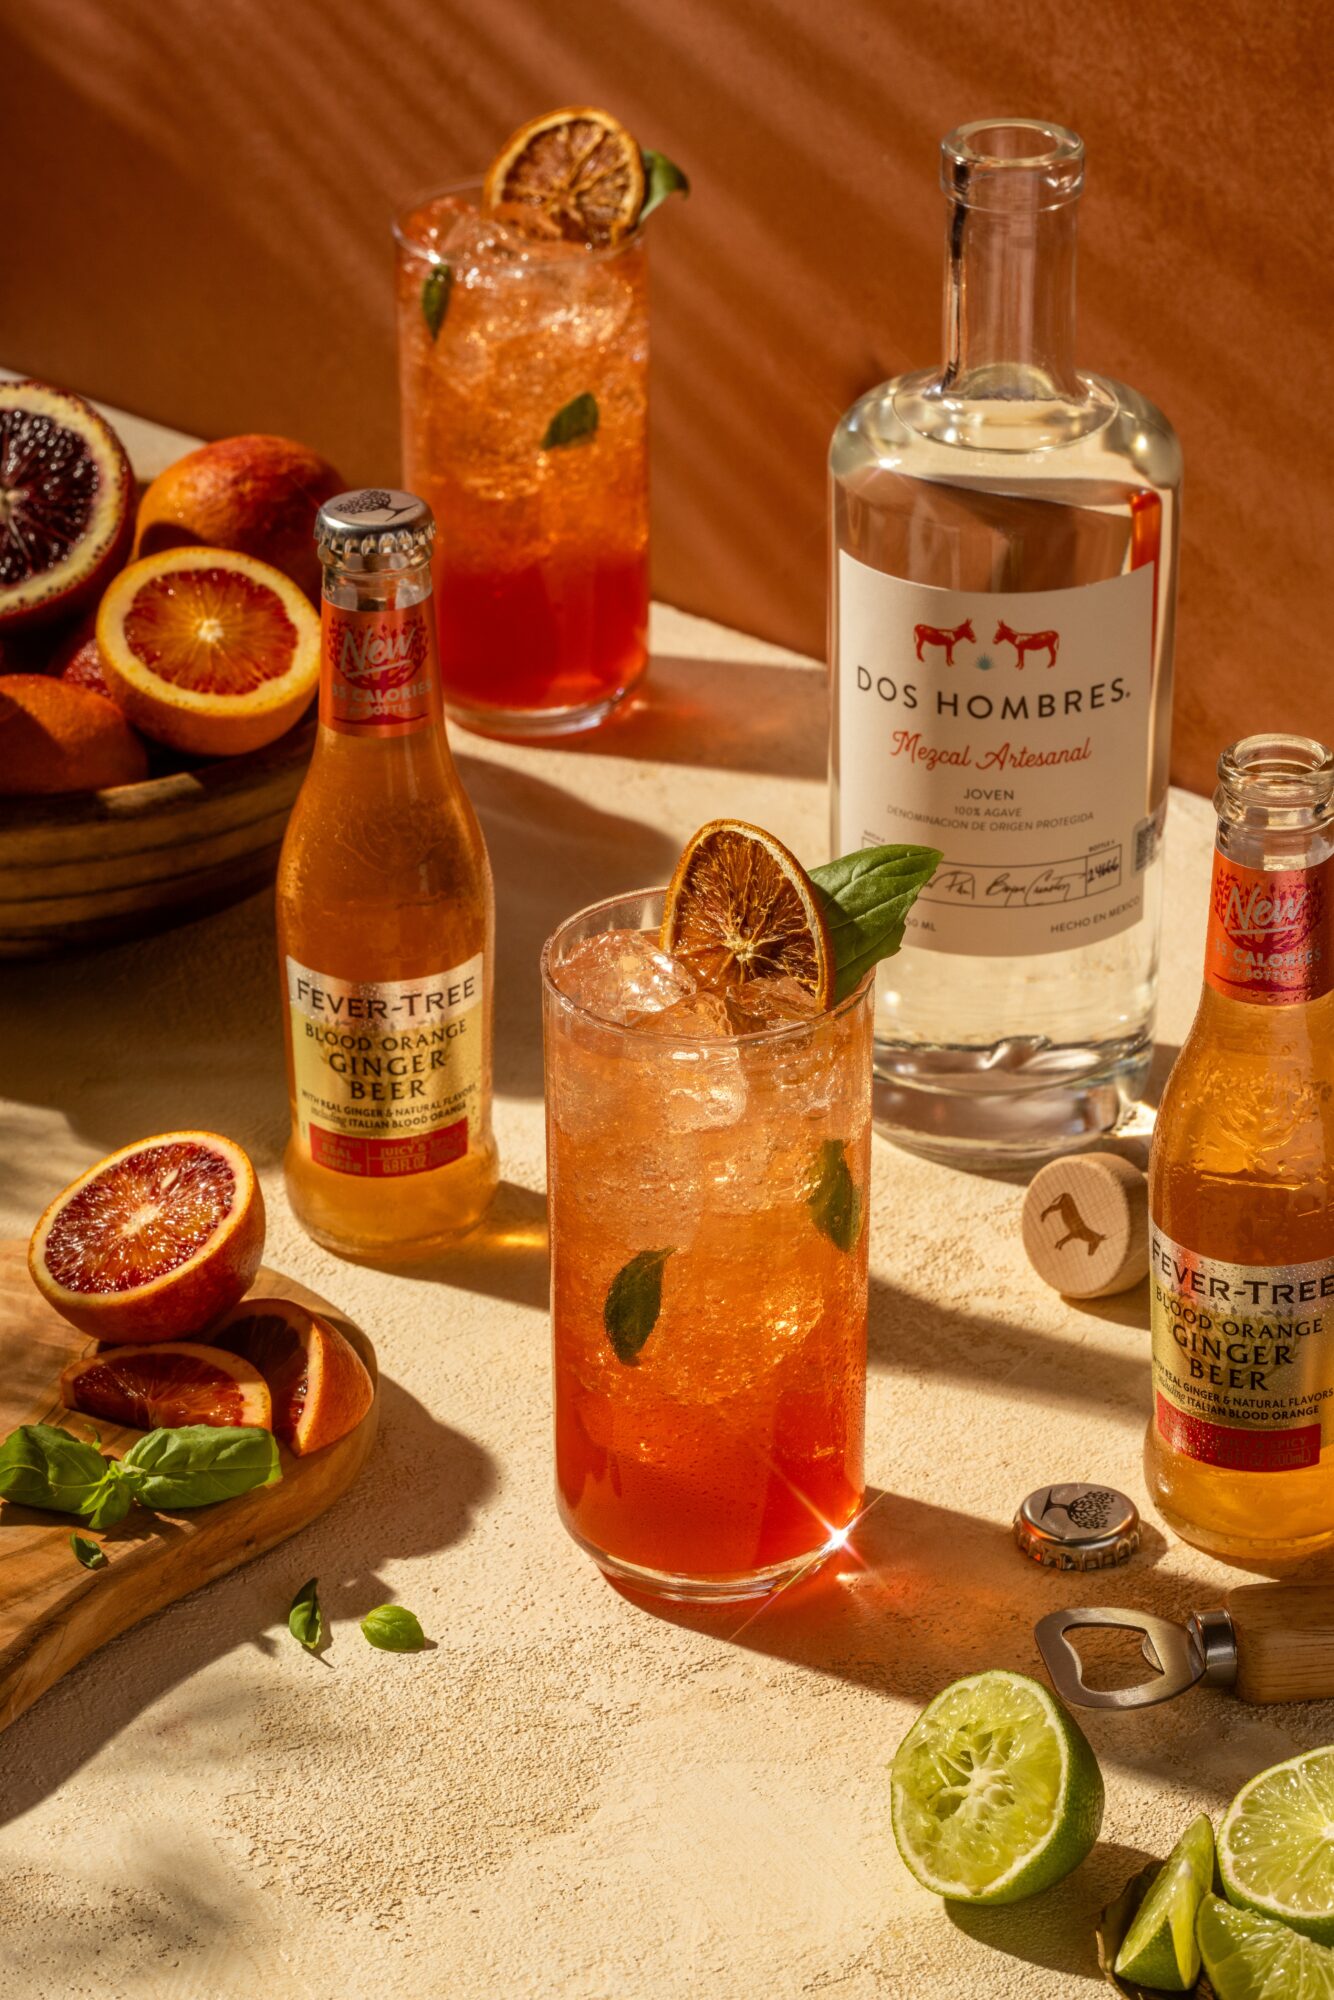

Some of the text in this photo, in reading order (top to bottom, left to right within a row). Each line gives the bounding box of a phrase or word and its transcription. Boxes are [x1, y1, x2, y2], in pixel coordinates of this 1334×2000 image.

[341, 627, 417, 675] New
[352, 678, 432, 703] CALORIES
[857, 666, 918, 709] DOS
[890, 731, 1092, 771] Mezcal Artesanal
[963, 788, 1014, 800] JOVEN
[954, 806, 1023, 818] 100% AGAVE
[971, 821, 986, 831] DE
[989, 821, 1033, 832] ORIGEN
[1036, 811, 1095, 829] PROTEGIDA
[1050, 917, 1091, 933] HECHO
[1093, 913, 1107, 924] EN
[1224, 886, 1311, 933] New
[921, 921, 936, 932] ML
[1233, 946, 1321, 968] CALORIES
[1245, 968, 1295, 981] BOTTLE
[297, 976, 475, 1019] FEVER-TREE
[306, 1019, 467, 1051] BLOOD ORANGE
[328, 1050, 446, 1077] GINGER
[302, 1089, 319, 1104] WITH
[320, 1099, 342, 1113] REAL
[344, 1105, 383, 1118] GINGER
[385, 1107, 393, 1118] &
[395, 1100, 441, 1117] NATURAL
[351, 1079, 426, 1101] BEER
[349, 1118, 389, 1129] ITALIAN
[392, 1113, 427, 1129] BLOOD
[430, 1099, 467, 1122] ORANGE
[1152, 1238, 1334, 1305] FEVER-TREE
[1156, 1286, 1324, 1339] BLOOD ORANGE
[1173, 1324, 1294, 1366] GINGER
[1190, 1357, 1269, 1391] BEER
[1165, 1369, 1182, 1388] REAL
[1183, 1382, 1220, 1404] GINGER
[1223, 1395, 1231, 1405] &
[1233, 1397, 1285, 1409] NATURAL
[1289, 1387, 1334, 1407] FLAVORS
[1187, 1397, 1226, 1416] ITALIAN
[1229, 1408, 1269, 1421] BLOOD
[1271, 1405, 1319, 1420] ORANGE
